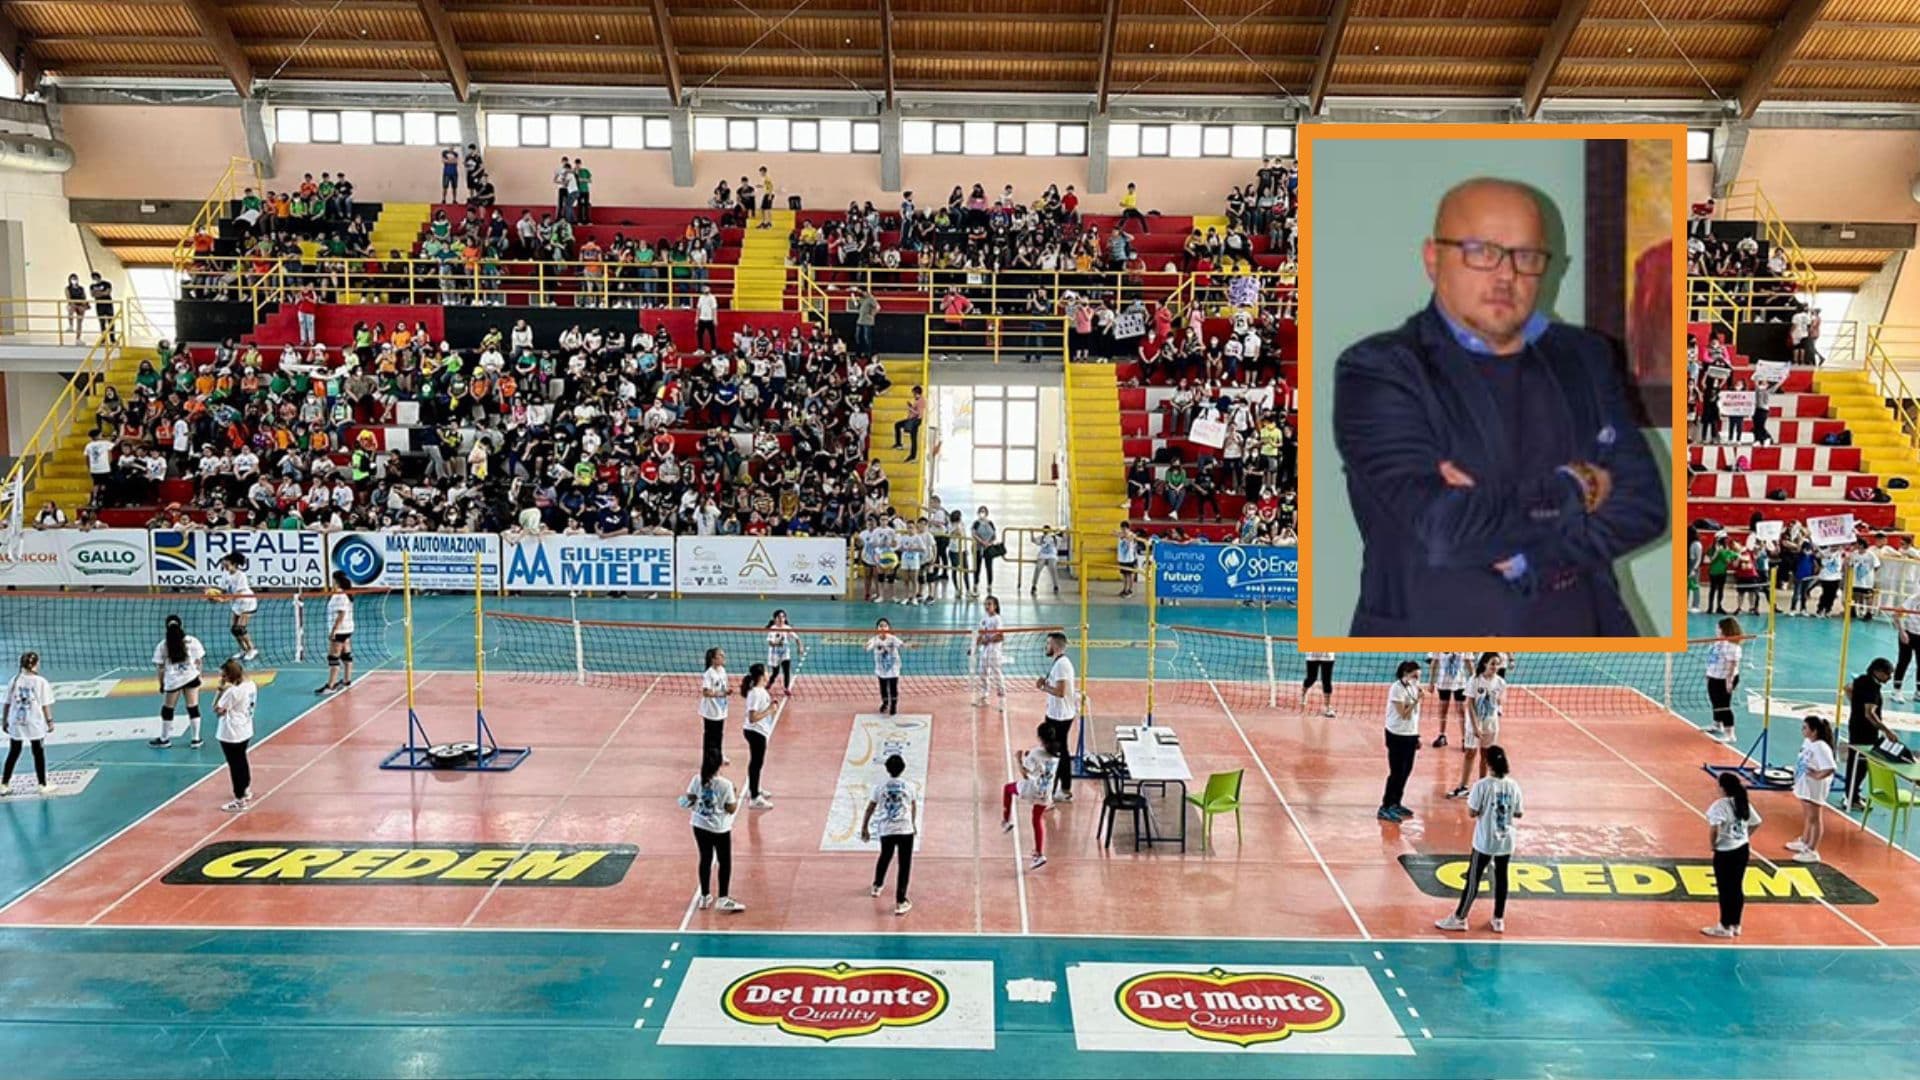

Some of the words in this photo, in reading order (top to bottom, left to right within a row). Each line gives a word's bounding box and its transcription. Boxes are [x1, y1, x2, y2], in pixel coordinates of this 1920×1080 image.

[206, 532, 319, 554] REALE
[386, 536, 410, 551] MAX
[413, 537, 486, 553] AUTOMAZIONI
[77, 550, 136, 563] GALLO
[560, 547, 671, 562] GIUSEPPE
[1164, 550, 1205, 561] Illumina
[561, 563, 671, 585] MIELE
[1185, 562, 1205, 571] tuo
[257, 575, 322, 586] POLINO
[1163, 572, 1202, 582] futuro
[1171, 583, 1204, 594] scegli
[201, 848, 611, 880] CREDEM
[1436, 861, 1825, 897] CREDEM
[744, 985, 804, 1005] Del
[811, 986, 932, 1006] Monte
[1135, 990, 1200, 1010] Del
[1200, 991, 1326, 1012] Monte
[787, 1005, 877, 1023] Quality
[1189, 1011, 1279, 1028] Quality
